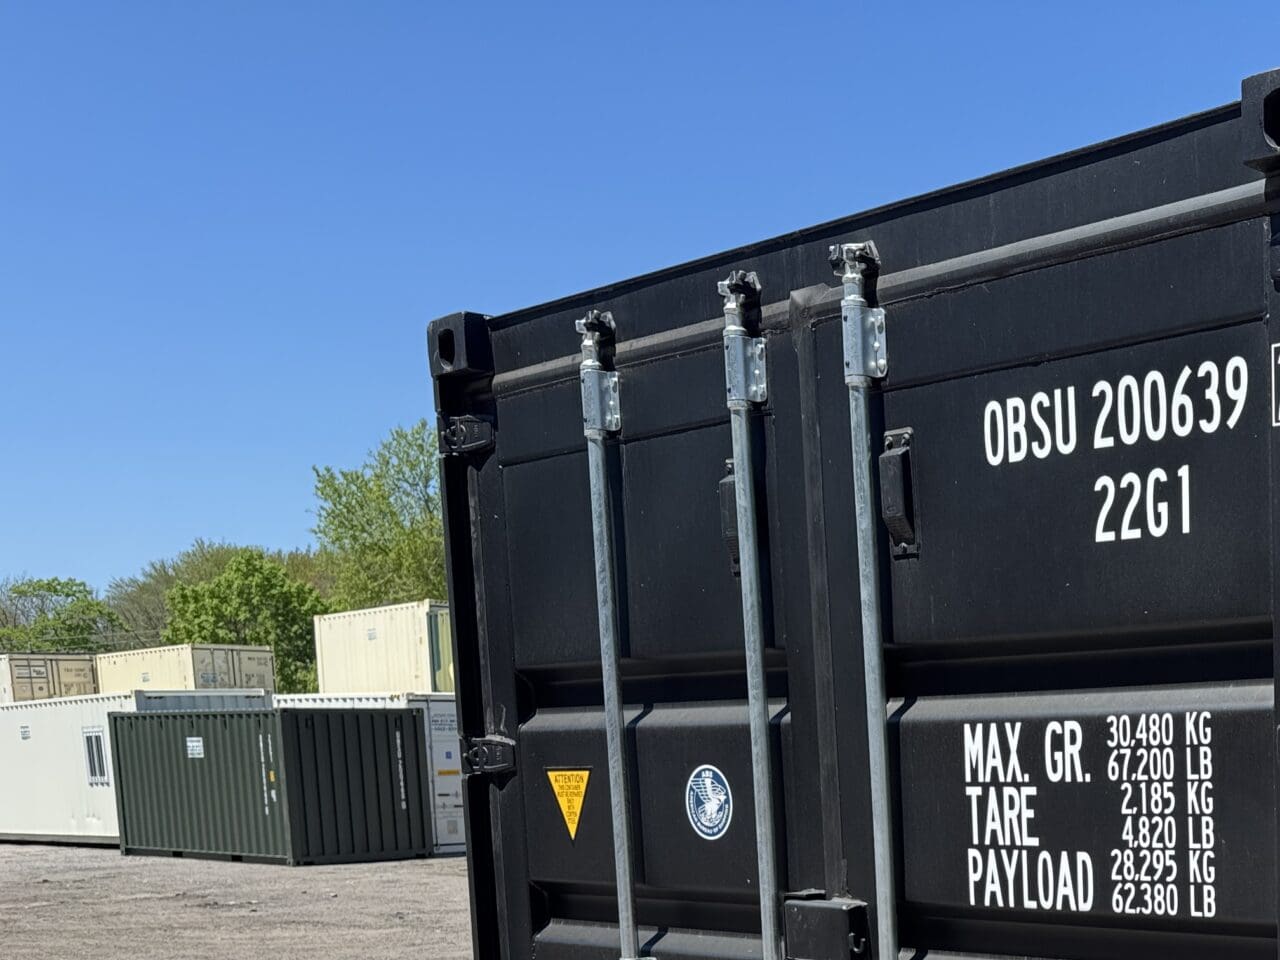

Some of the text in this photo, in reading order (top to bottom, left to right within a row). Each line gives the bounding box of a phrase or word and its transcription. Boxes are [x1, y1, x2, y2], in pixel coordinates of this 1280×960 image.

[984, 386, 1077, 466] OBSU
[1092, 356, 1249, 449] 200639
[1093, 464, 1190, 543] 22G1
[963, 711, 1212, 783] MAX. GR. 30,480 KG
[1107, 746, 1213, 782] 67,200 LB
[965, 781, 1214, 847] TARE 2,185 KG
[1121, 816, 1215, 849] 4,820 LB
[967, 848, 1216, 912] PAYLOAD 28,295 KG
[1111, 883, 1216, 918] 62,380 LB
